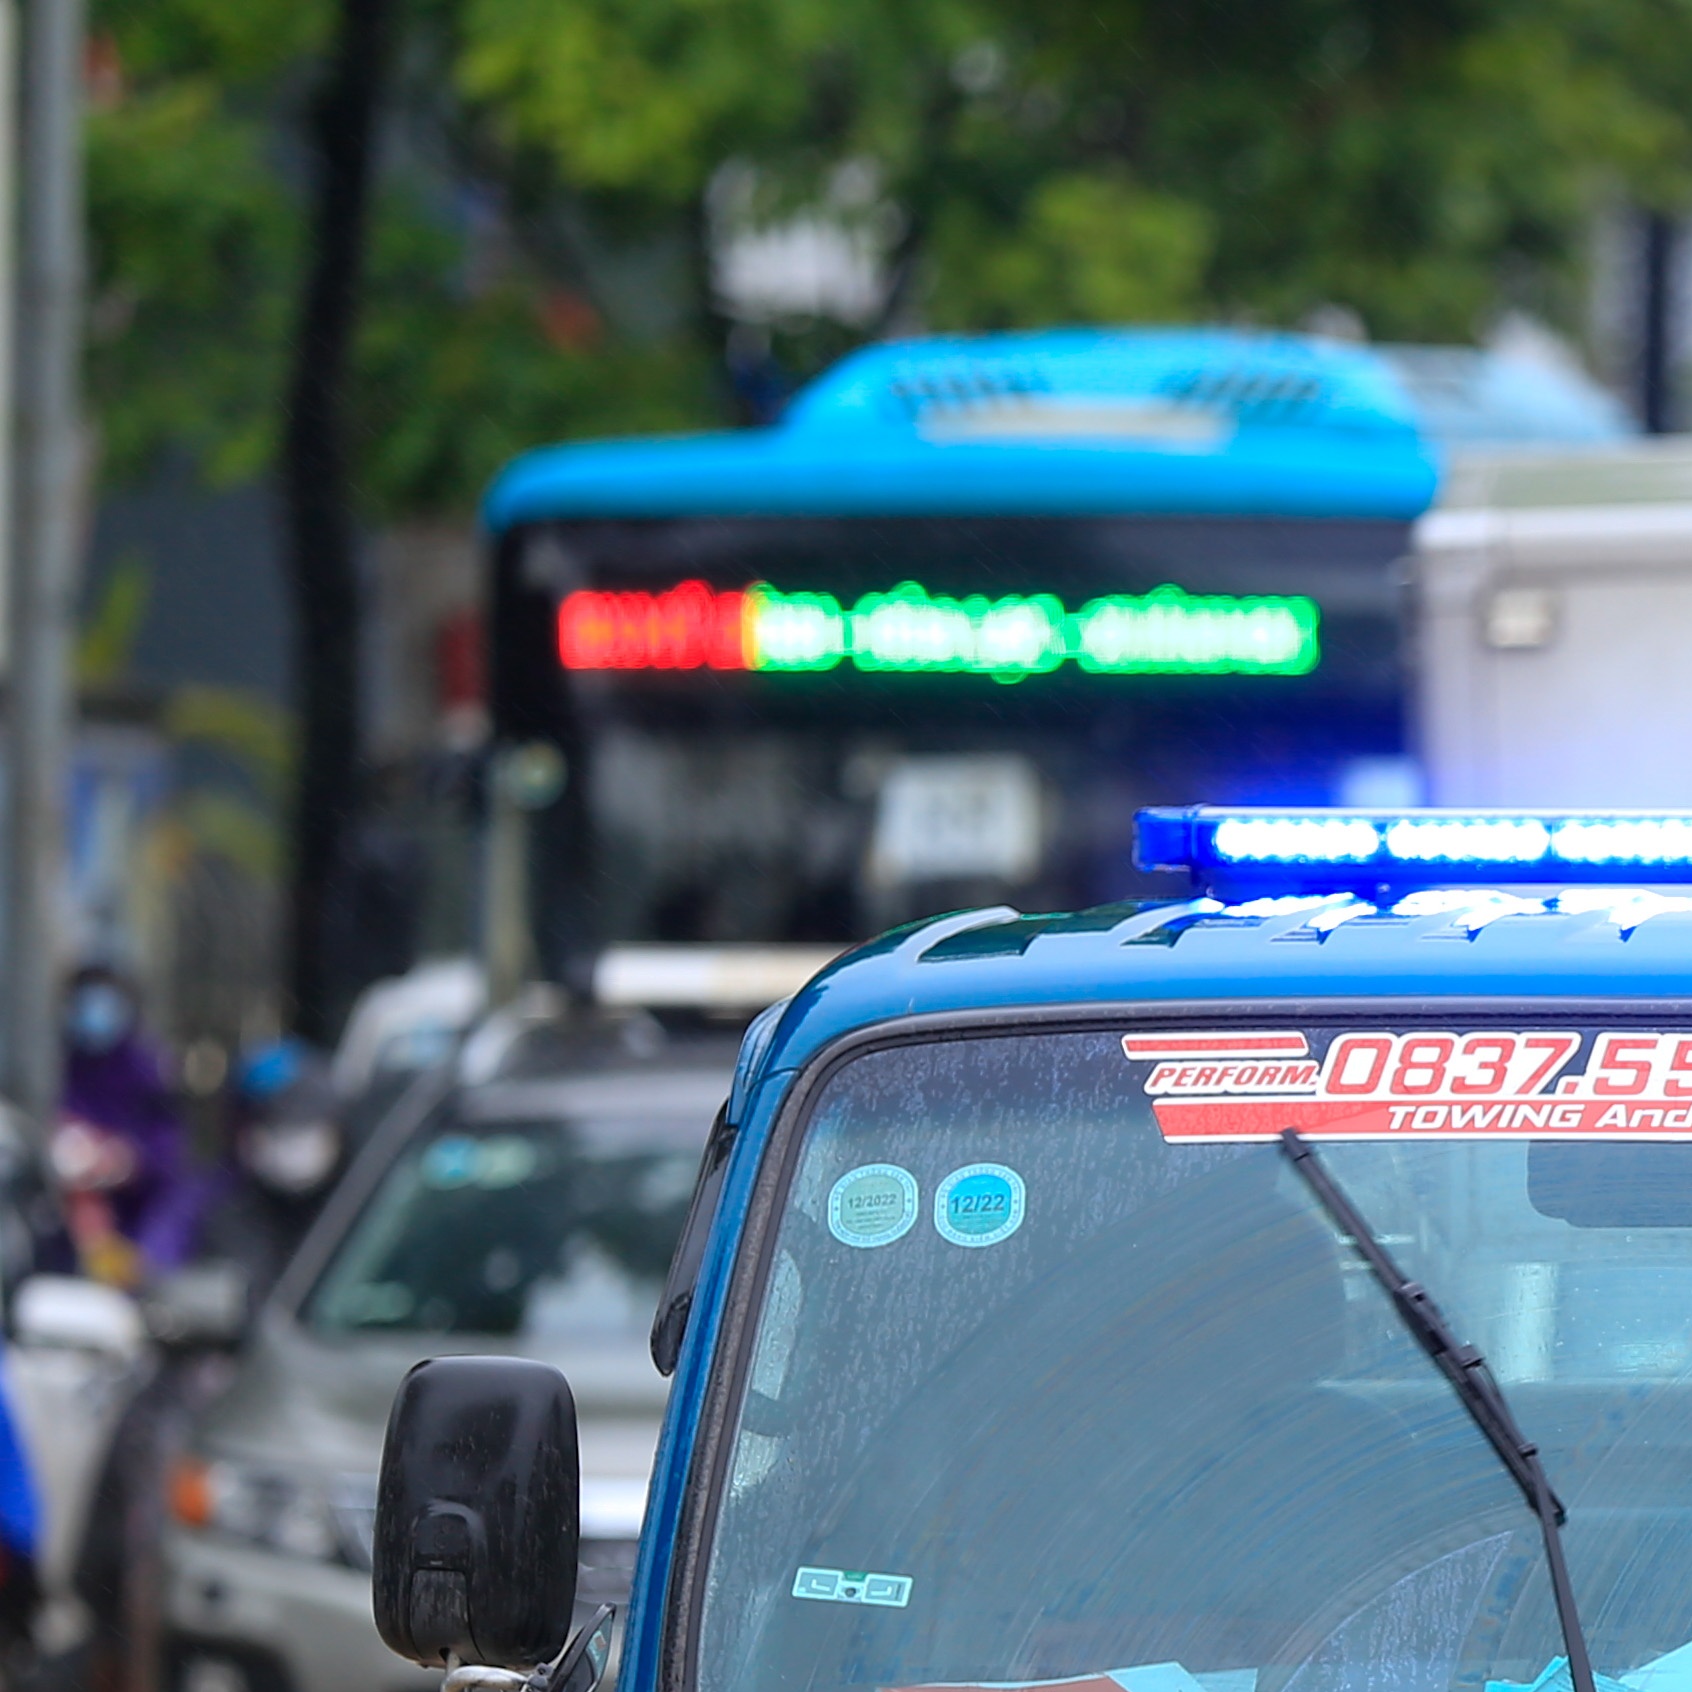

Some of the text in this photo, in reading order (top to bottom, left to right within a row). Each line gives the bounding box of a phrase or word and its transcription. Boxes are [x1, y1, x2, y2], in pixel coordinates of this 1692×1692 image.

[1388, 1104, 1583, 1130] TOWING
[848, 1193, 897, 1209] 12/2022
[951, 1193, 1005, 1214] 12/22
